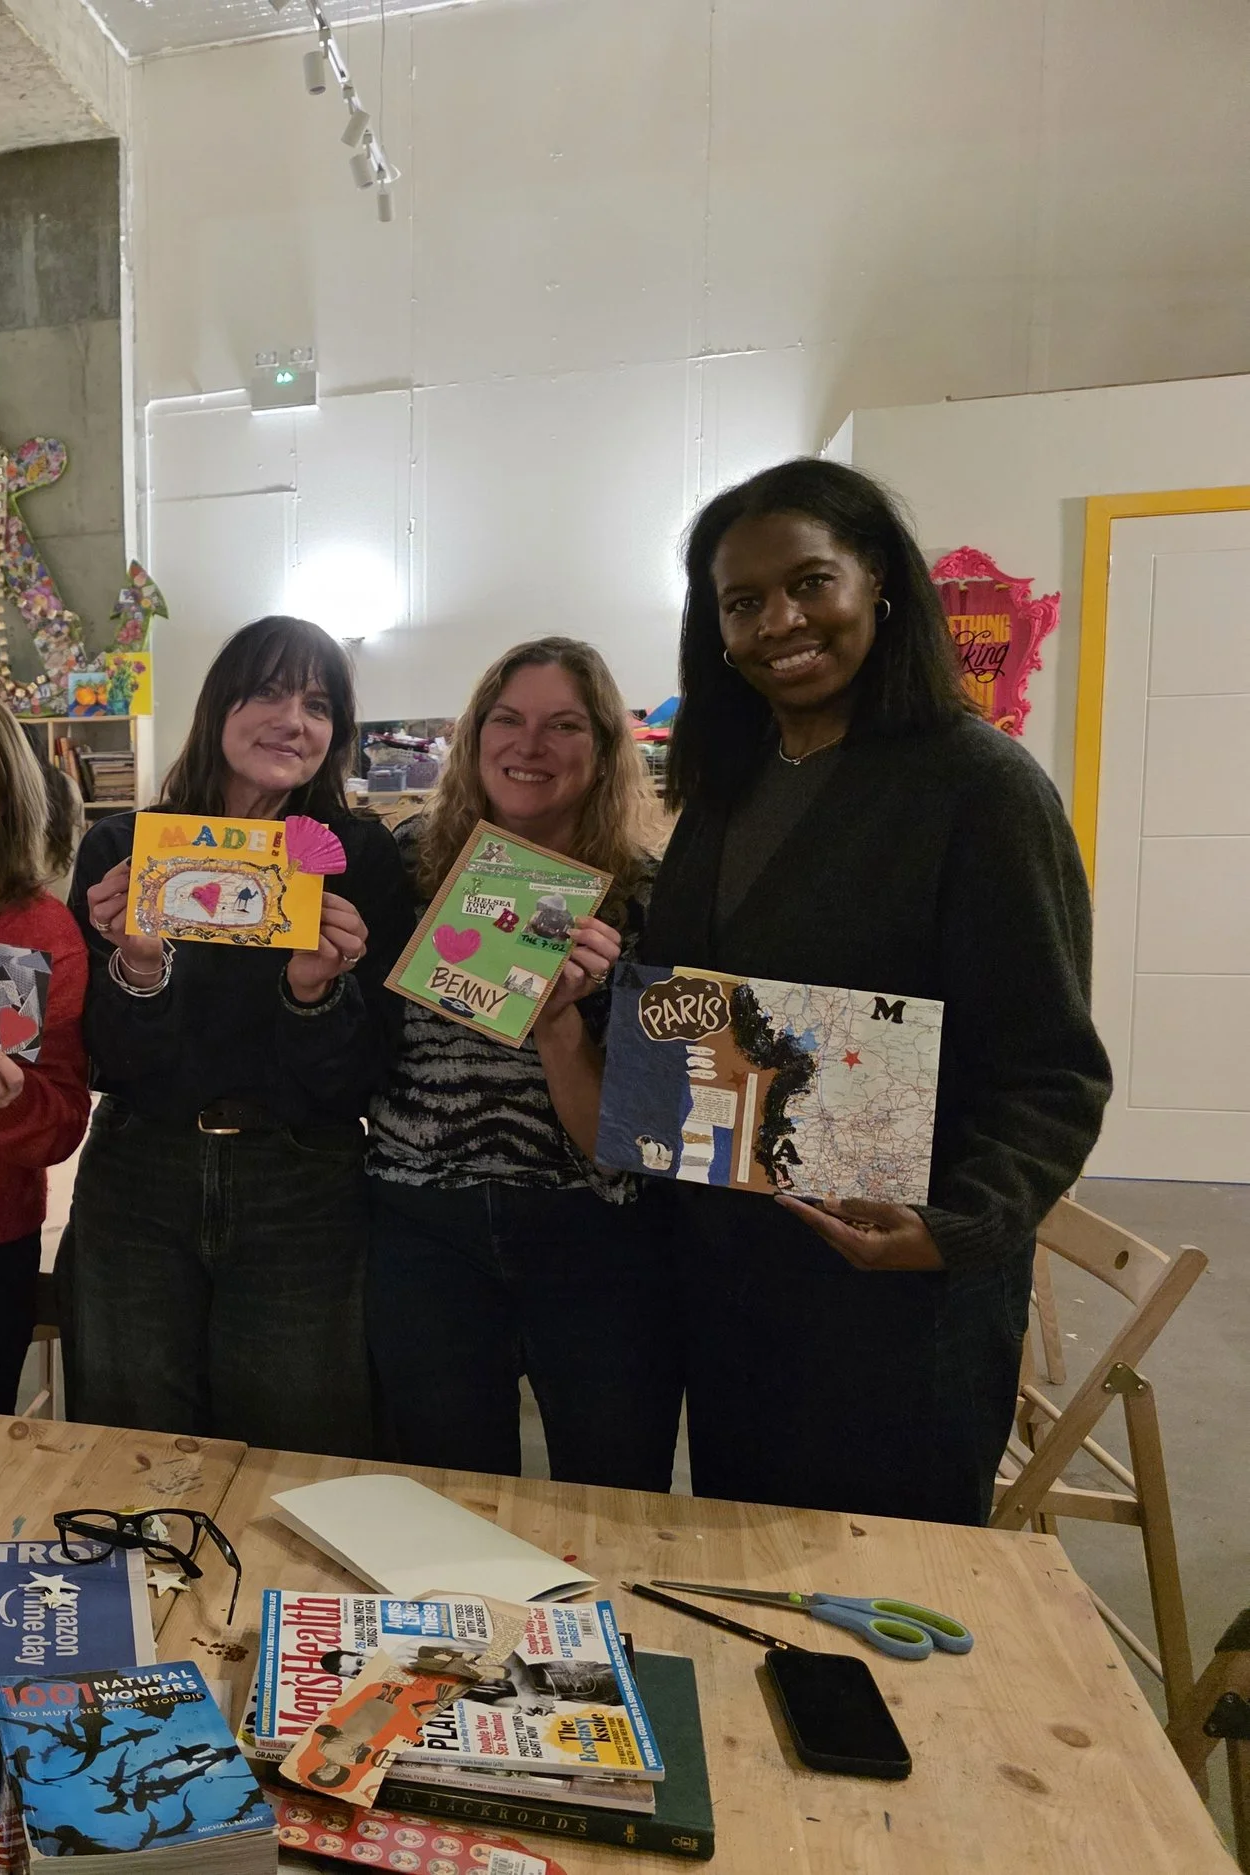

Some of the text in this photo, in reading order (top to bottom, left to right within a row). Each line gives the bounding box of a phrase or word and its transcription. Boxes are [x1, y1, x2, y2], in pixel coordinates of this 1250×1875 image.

[465, 906, 492, 916] HALL
[466, 902, 496, 911] TOWN
[467, 895, 512, 908] CHELSEA
[521, 934, 538, 946] THE
[430, 966, 509, 1014] BENNY
[643, 993, 722, 1036] PARIS
[870, 996, 906, 1024] M
[353, 1599, 366, 1649] 26 AMAZING NEW
[365, 1599, 378, 1648] DRUGS FOR MEN
[385, 1602, 403, 1629] Arms
[403, 1603, 421, 1626] Like
[421, 1604, 440, 1635] These
[454, 1604, 468, 1637] BEAT STRESS
[464, 1604, 477, 1633] WITH DOGS
[474, 1605, 488, 1638] AND CHEESE!
[525, 1634, 540, 1655] Simple
[533, 1608, 554, 1655] Shrink Your Gut
[553, 1608, 573, 1658] EAT THE BULK-UP
[566, 1622, 582, 1647] BURGER!
[15, 1635, 51, 1666] day
[1, 1669, 193, 1708] 1001 NATURAL
[98, 1680, 199, 1702] WONDERS
[11, 1692, 205, 1718] YOU MUST SEE BEFORE YOU DIE
[631, 1707, 641, 1715] TO
[475, 1714, 493, 1754] Double Your
[489, 1711, 510, 1755] Sex Stamina!
[512, 1716, 529, 1757] PROTECT YOUR
[558, 1719, 578, 1744] The
[591, 1713, 612, 1742] Issue
[616, 1717, 626, 1728] MIND
[633, 1715, 648, 1736] GUIDE
[462, 1736, 470, 1745] Your
[527, 1724, 544, 1759] HEART NOW
[574, 1717, 599, 1762] Ecstasy
[626, 1750, 637, 1765] HEALTH
[644, 1749, 658, 1767] YOUR
[197, 1815, 265, 1834] MICHAEL BRIGHT
[429, 1797, 587, 1833] BACKROADS
